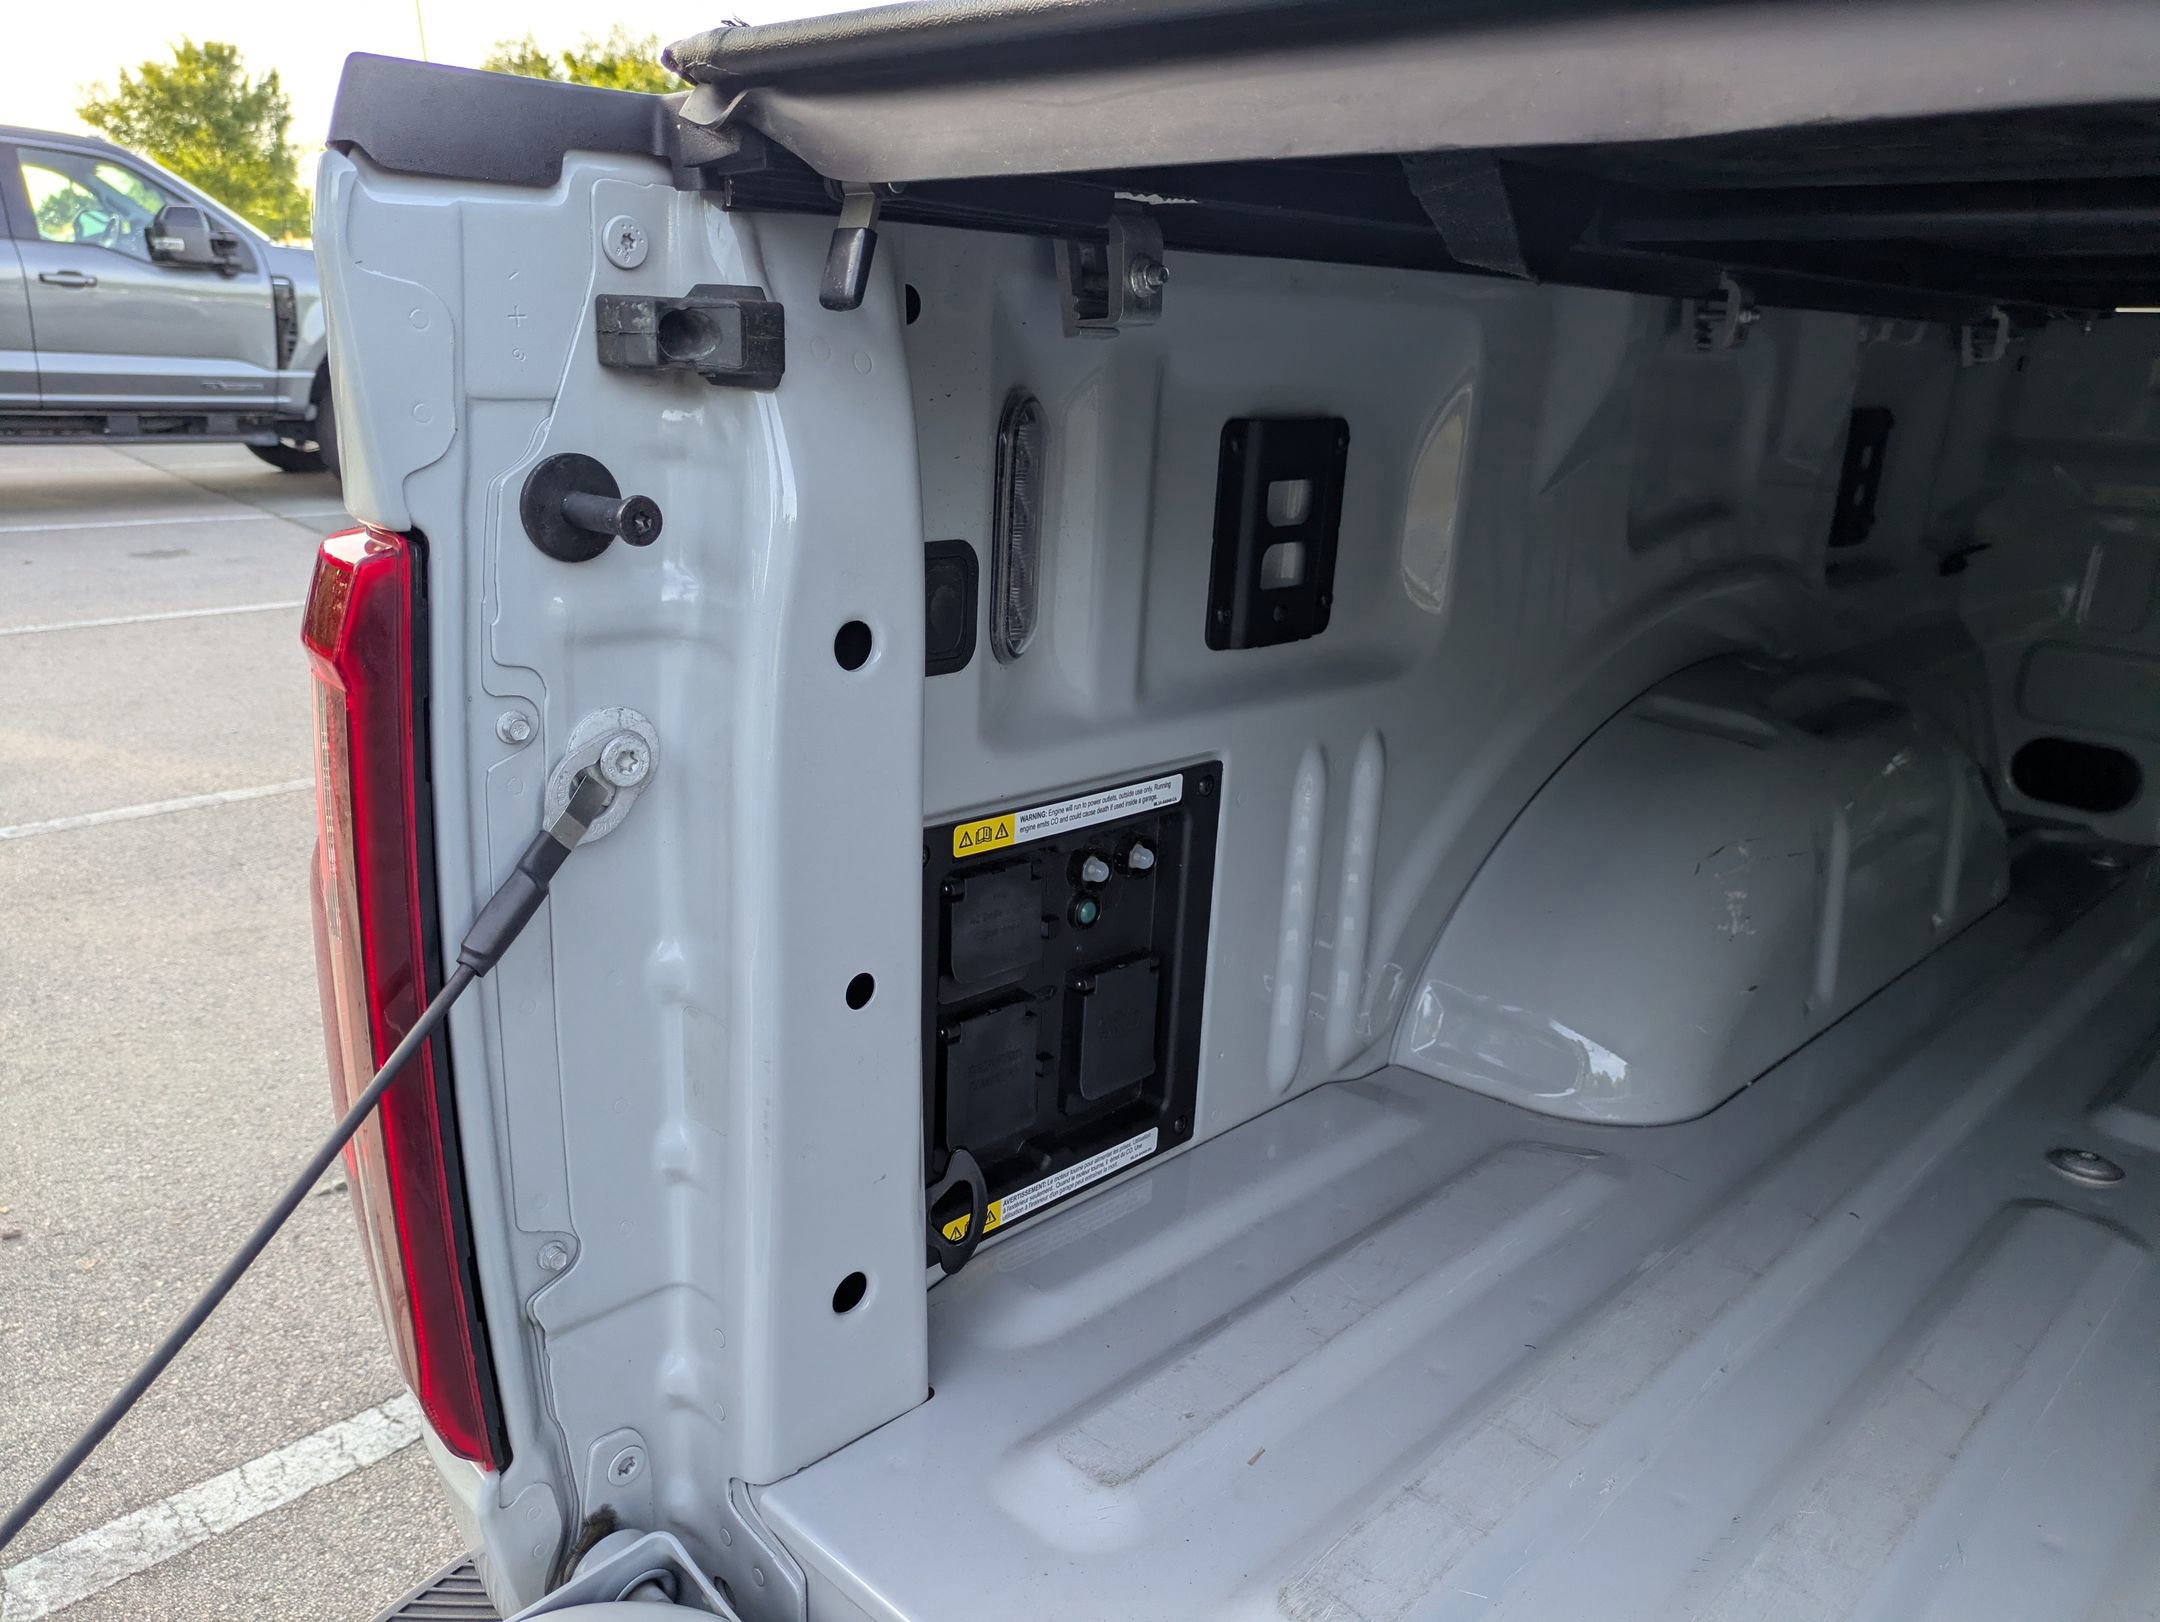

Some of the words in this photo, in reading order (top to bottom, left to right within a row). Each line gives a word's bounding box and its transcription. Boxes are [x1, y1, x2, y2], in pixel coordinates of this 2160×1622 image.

[1019, 810, 1047, 823] WARNING:
[1048, 806, 1064, 817] Engine
[1087, 800, 1100, 808] power
[1102, 795, 1116, 803] outlets,
[1118, 791, 1134, 799] outside
[1154, 782, 1171, 792] Running
[1019, 825, 1035, 834] engine
[1050, 817, 1058, 825] CO
[1069, 812, 1081, 820] could
[1142, 796, 1156, 804] garage.
[1055, 1177, 1070, 1187] Quand
[1075, 1169, 1089, 1177] moteur
[1134, 1142, 1142, 1150] Une
[1003, 1181, 1046, 1206] AVERTISSEMENT:
[1054, 1172, 1069, 1181] moteur
[1070, 1165, 1082, 1173] tourne
[1059, 1183, 1073, 1193] garage
